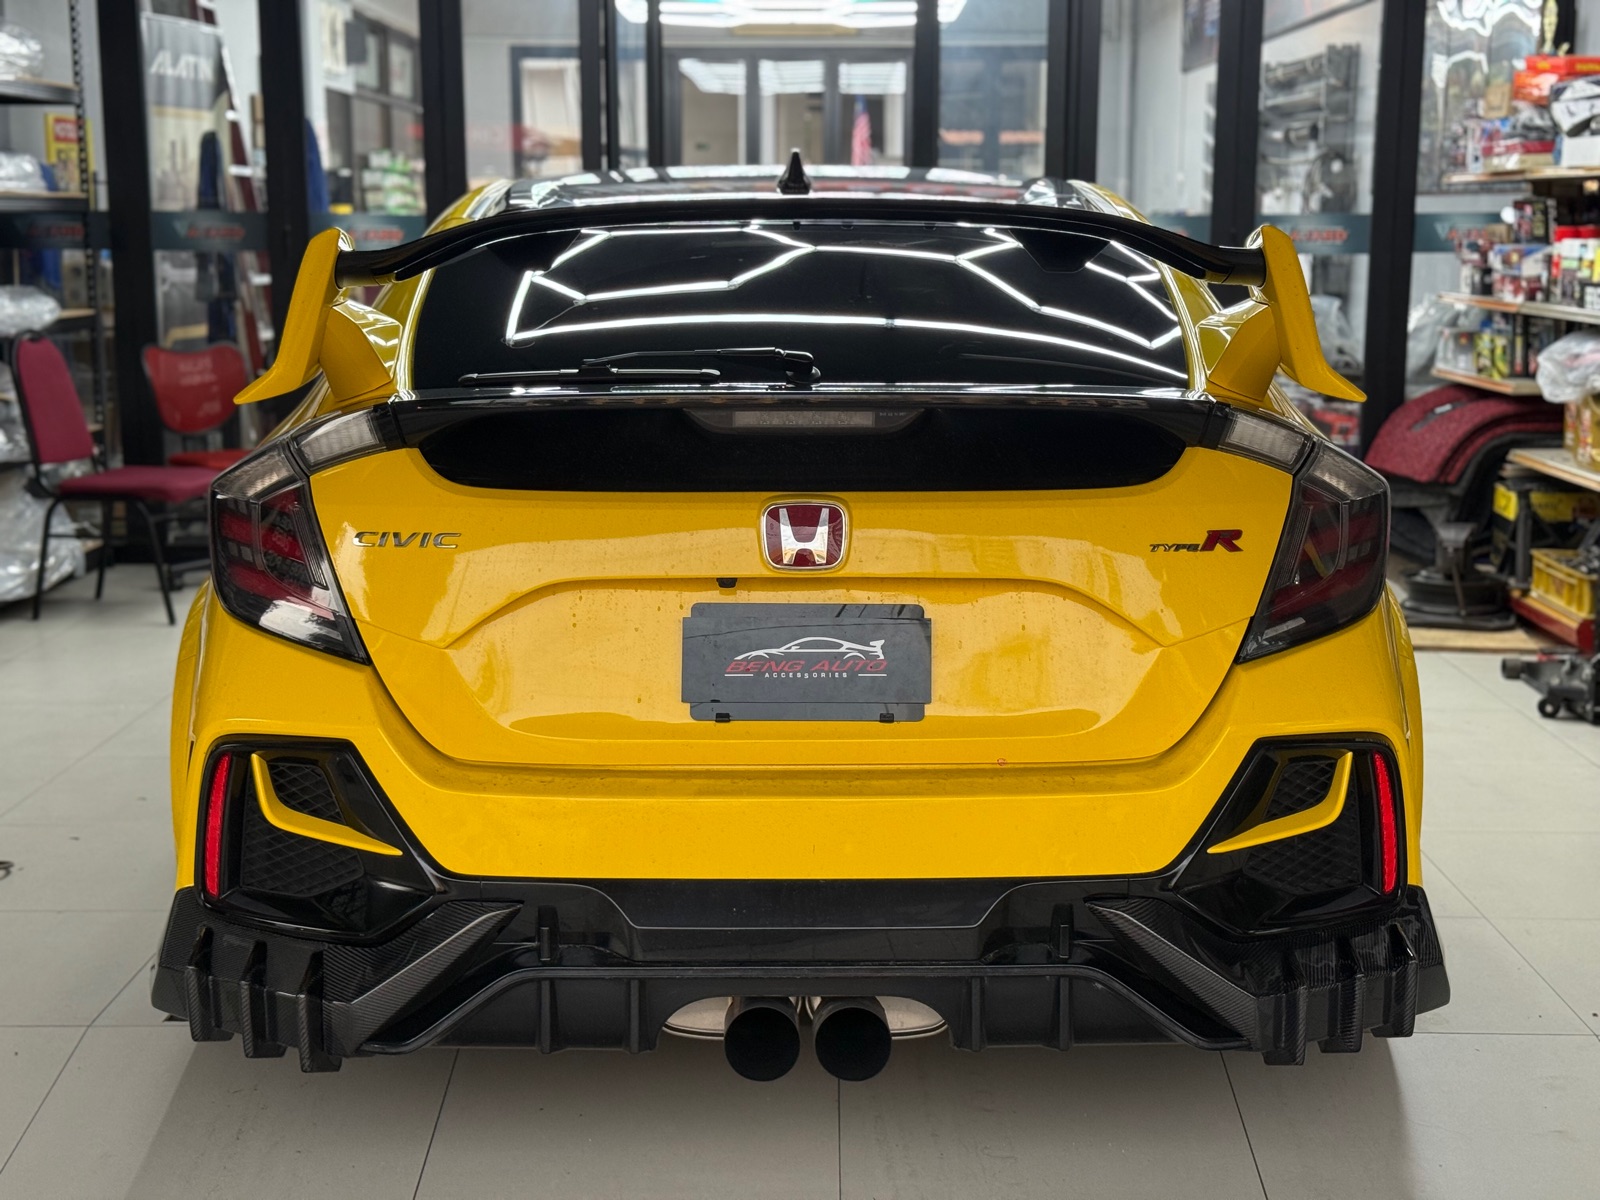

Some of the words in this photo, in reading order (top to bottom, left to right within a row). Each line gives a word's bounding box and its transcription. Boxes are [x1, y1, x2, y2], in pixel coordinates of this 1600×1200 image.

[352, 531, 461, 549] CIVIC
[725, 659, 805, 673] BENG
[810, 659, 888, 673] AUTO
